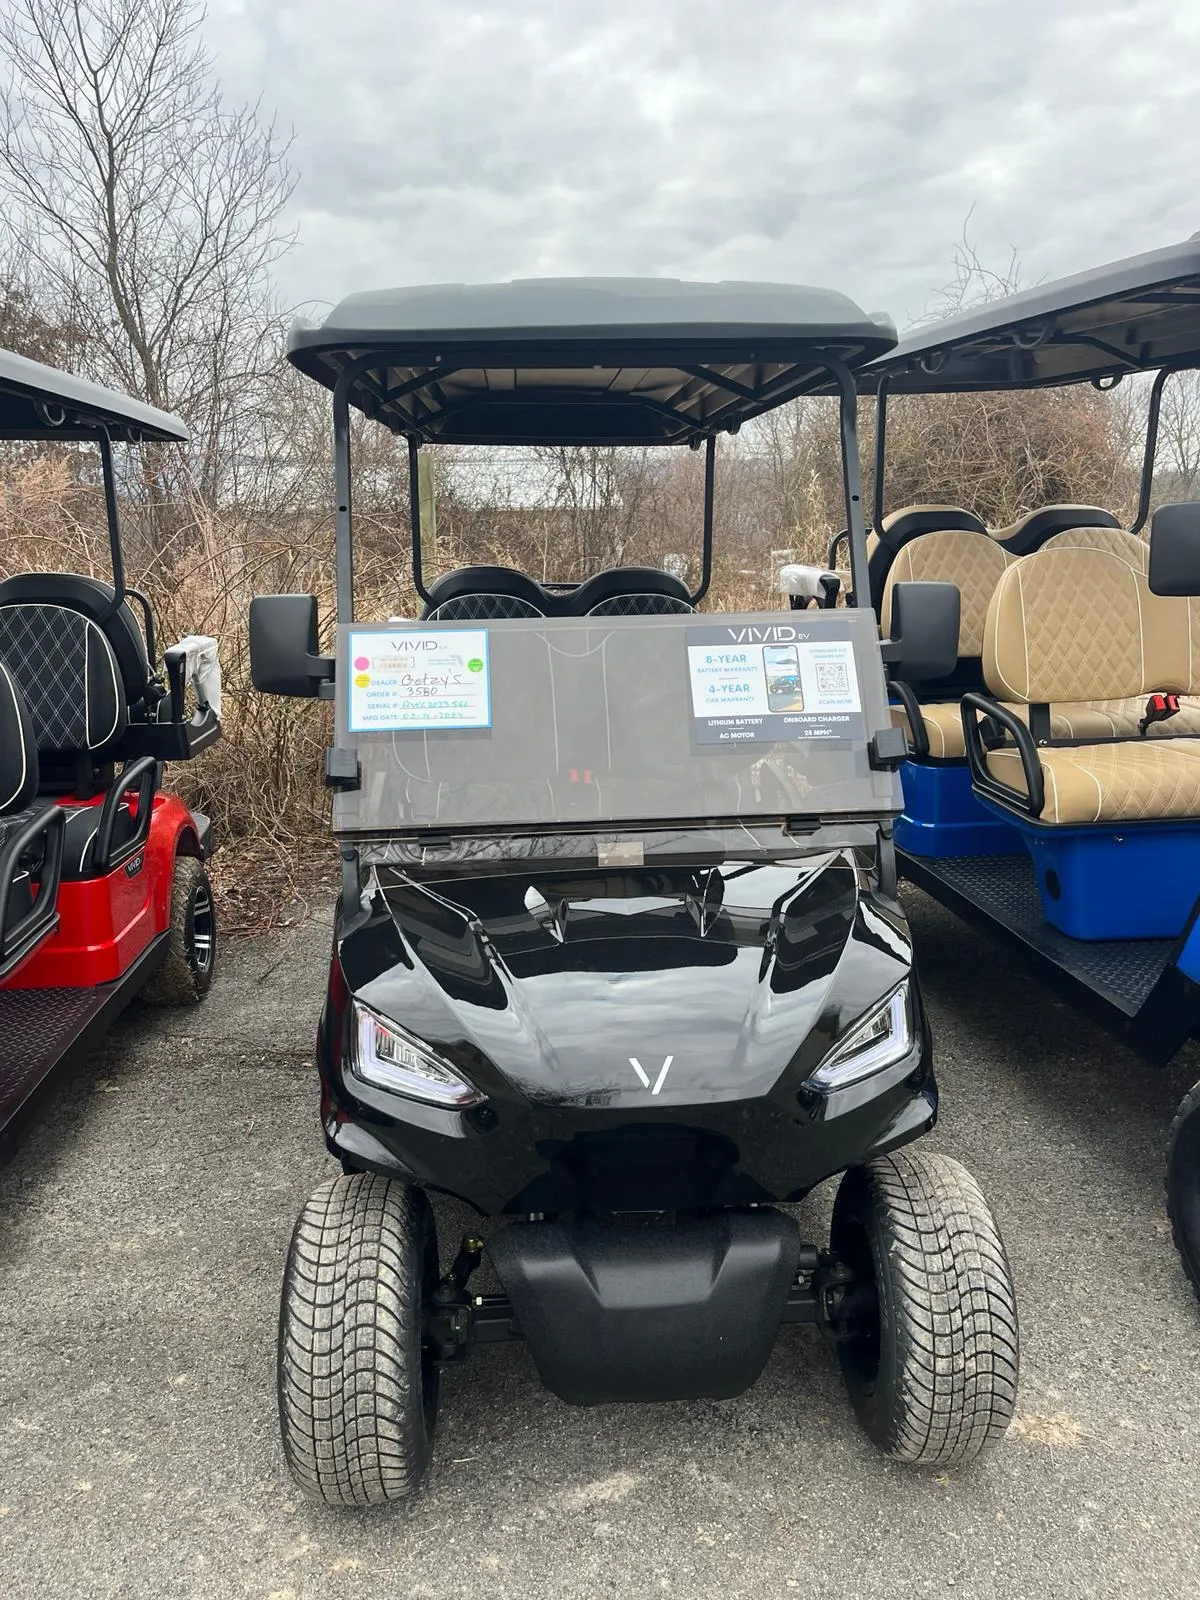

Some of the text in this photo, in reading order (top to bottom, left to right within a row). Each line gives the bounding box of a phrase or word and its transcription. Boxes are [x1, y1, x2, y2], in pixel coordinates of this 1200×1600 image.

[728, 626, 810, 643] VIVID EV
[391, 640, 438, 651] VIVID
[705, 654, 747, 664] 8-YEAR
[708, 684, 751, 693] 4-YEAR
[708, 718, 764, 727] LITHIUM BATTERY
[783, 716, 817, 724] ONBOARD
[731, 731, 755, 739] MOTOR
